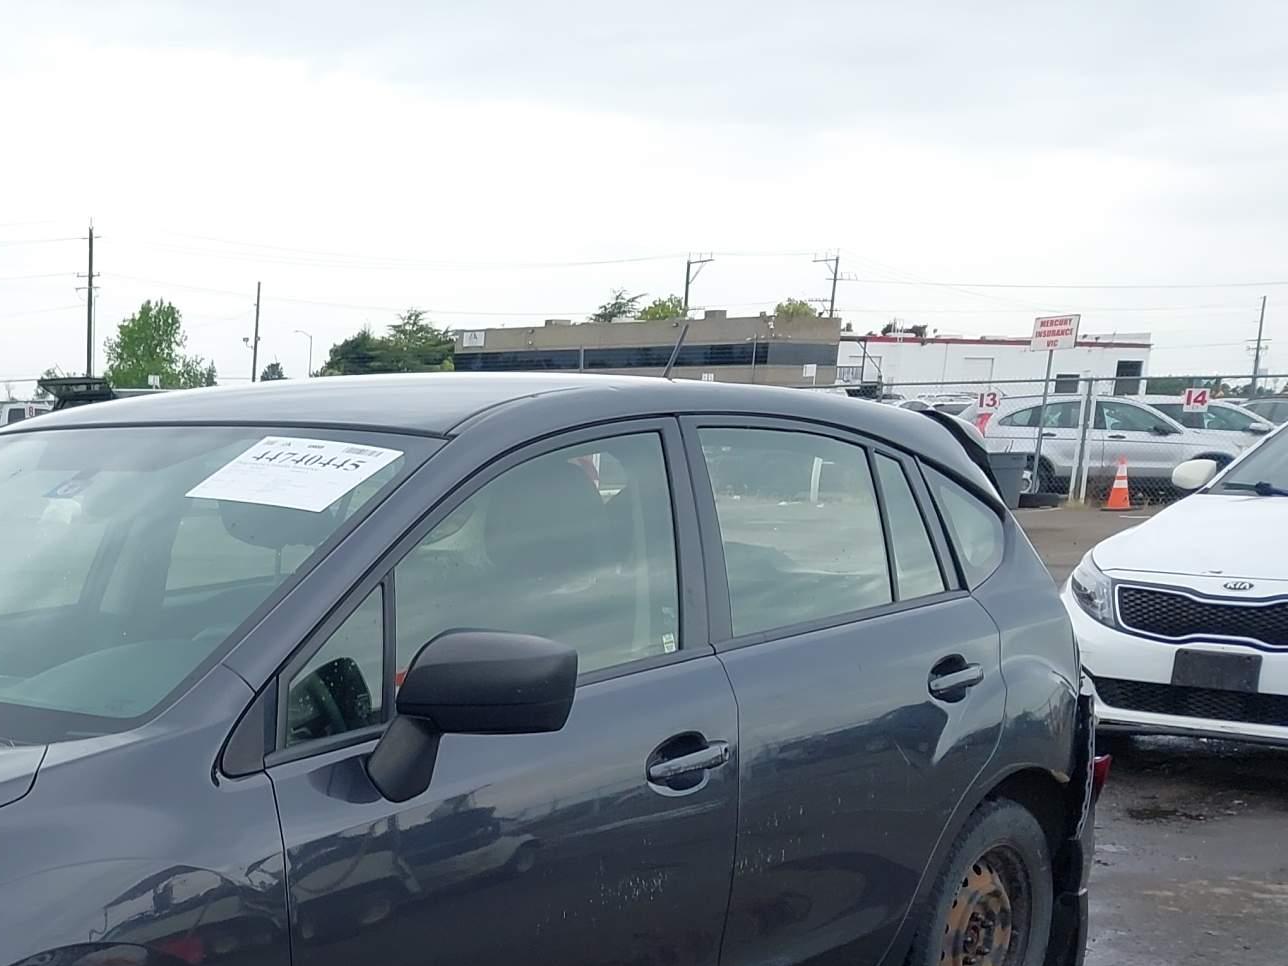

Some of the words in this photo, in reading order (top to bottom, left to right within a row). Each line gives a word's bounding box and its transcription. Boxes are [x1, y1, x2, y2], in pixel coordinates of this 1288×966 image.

[1040, 318, 1072, 327] MERCURY
[1035, 328, 1073, 338] INSURANCE
[979, 392, 997, 408] 13
[1186, 390, 1207, 406] 14
[252, 450, 366, 472] 44740445
[1225, 581, 1251, 590] KIA
